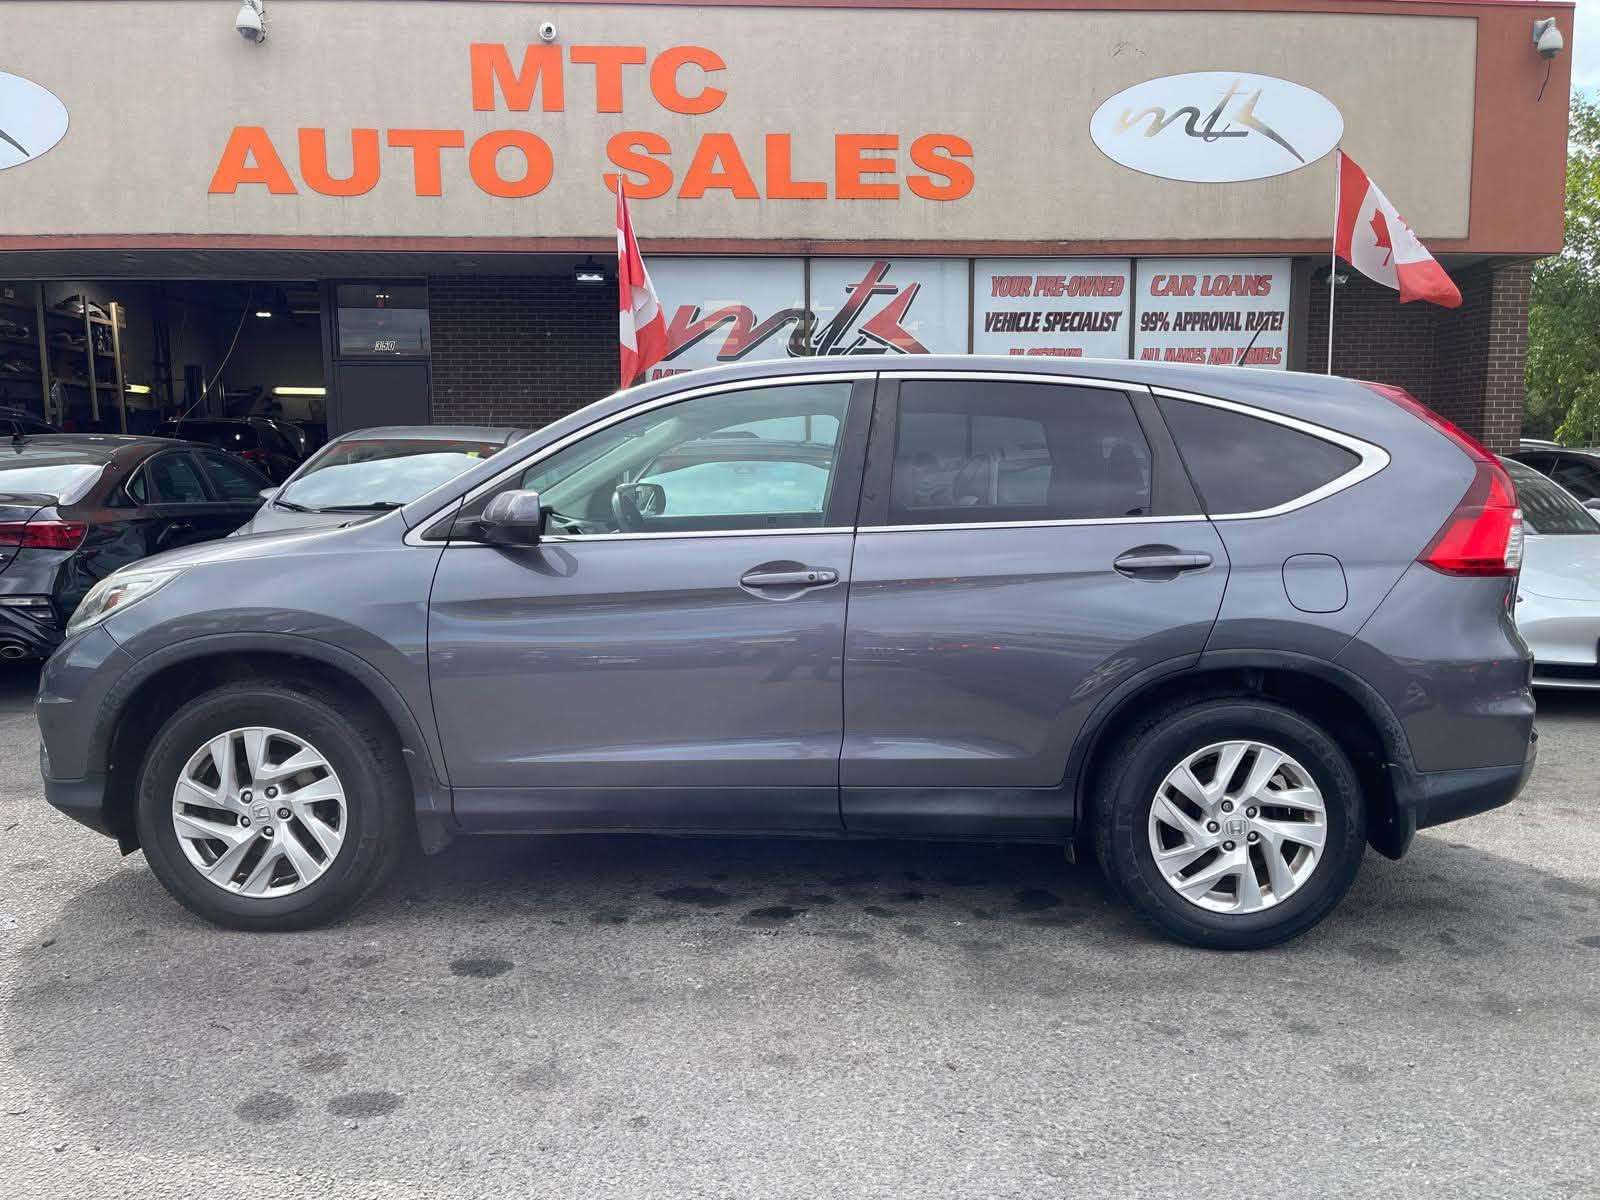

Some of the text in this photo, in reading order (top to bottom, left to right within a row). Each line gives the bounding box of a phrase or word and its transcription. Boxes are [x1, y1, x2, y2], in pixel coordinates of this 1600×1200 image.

[470, 43, 728, 115] MTC
[207, 126, 975, 201] AUTO SALES
[991, 276, 1125, 297] YOUR PRE-OWNED
[1151, 275, 1273, 296] CAR LOANS
[985, 312, 1123, 332] VEHICLE SPECIALIST
[1140, 312, 1285, 332] 99% APPROVAL RATE!
